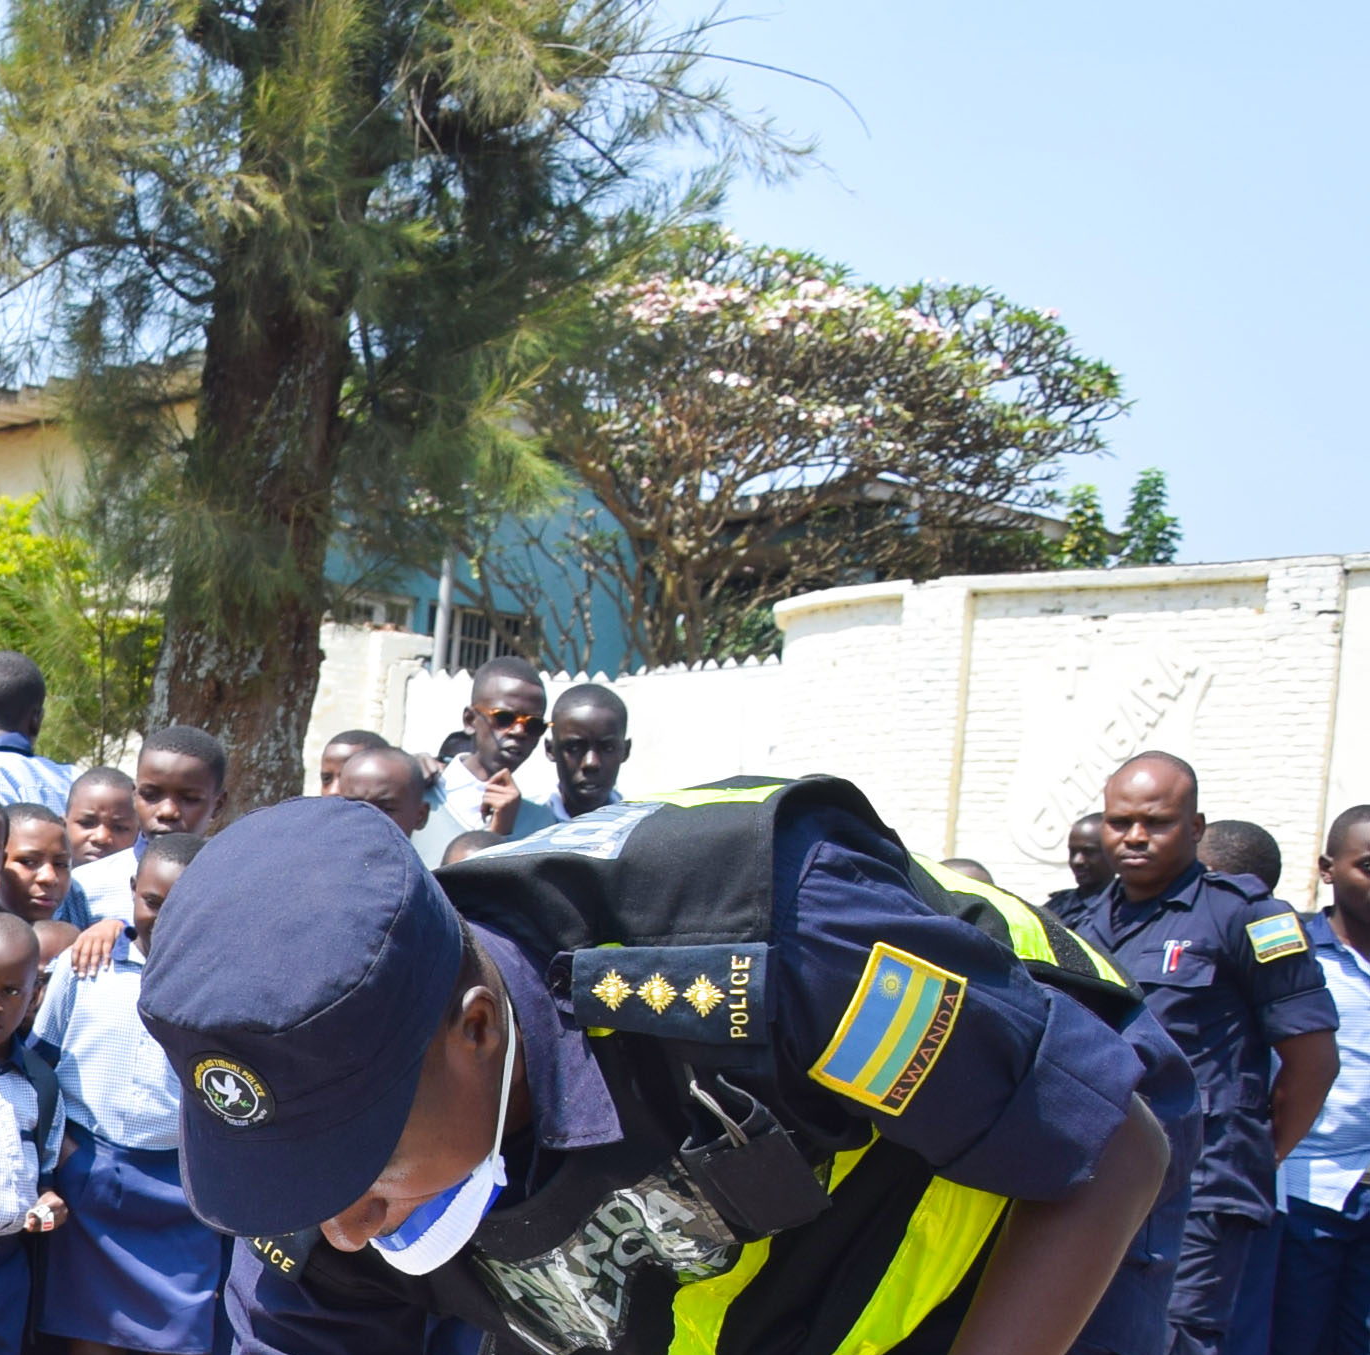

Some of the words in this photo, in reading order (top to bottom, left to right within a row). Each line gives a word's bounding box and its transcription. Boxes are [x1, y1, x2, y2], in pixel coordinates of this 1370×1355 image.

[730, 955, 752, 1039] POLICE
[889, 991, 959, 1102] RWANDA
[241, 1071, 266, 1097] POLICE
[253, 1237, 296, 1273] LICE
